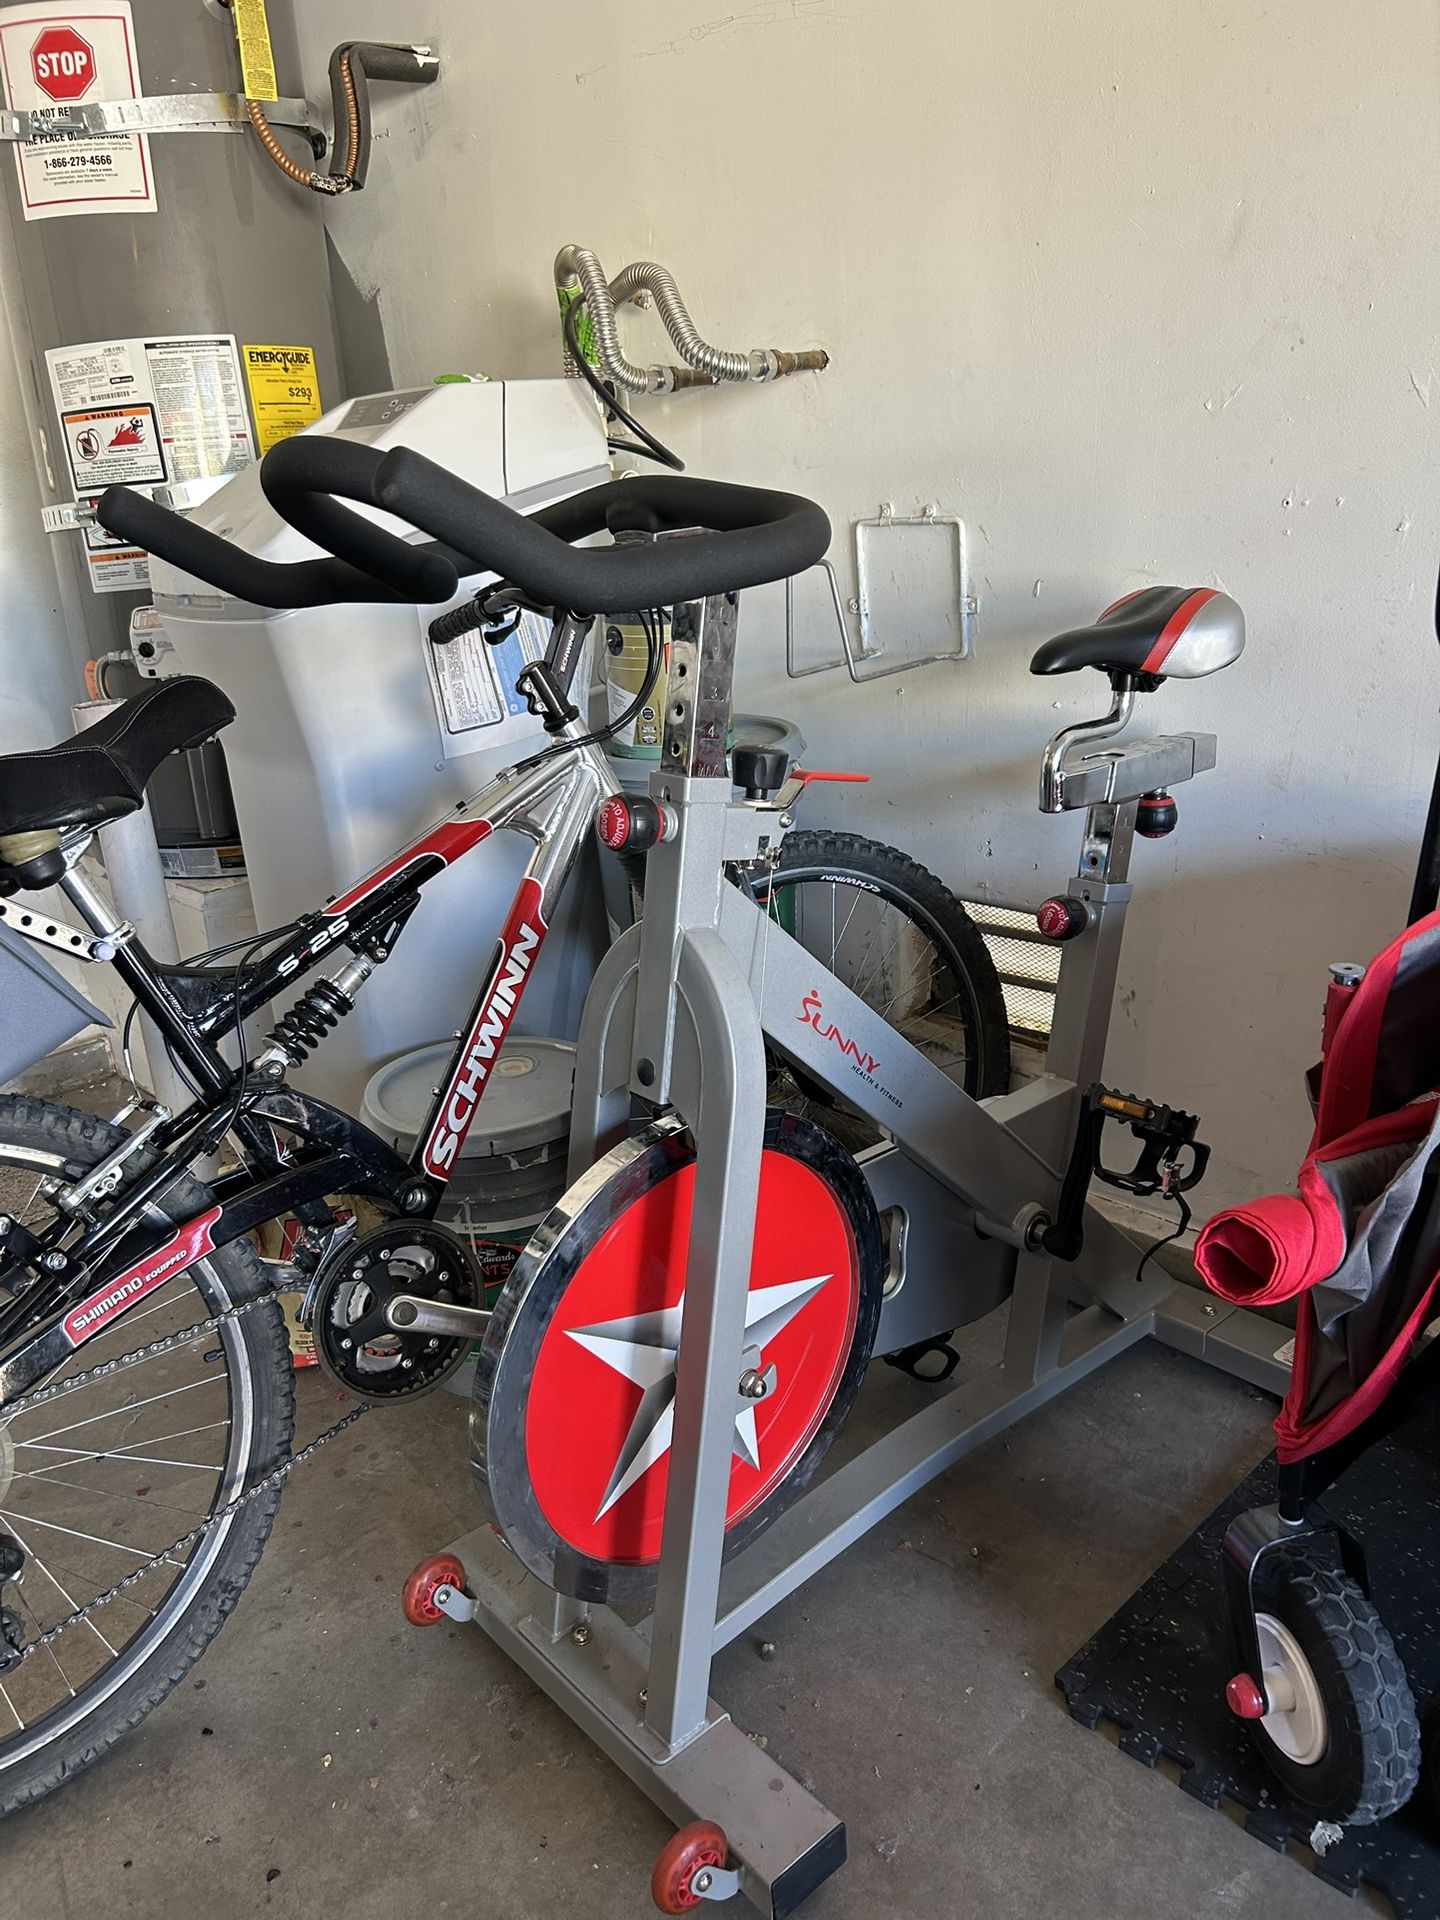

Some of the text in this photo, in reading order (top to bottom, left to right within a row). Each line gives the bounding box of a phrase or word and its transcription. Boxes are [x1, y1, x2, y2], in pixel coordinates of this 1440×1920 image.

[37, 51, 88, 78] STOP
[39, 109, 55, 117] NOT
[40, 133, 65, 144] PLACE
[44, 155, 112, 169] 1-866-279-4566
[248, 351, 311, 365] ENERGYGUIDE
[288, 387, 312, 398] $293
[91, 411, 124, 419] WARNING
[560, 629, 576, 673] SCHWINN
[611, 804, 625, 847] TO ADJUST
[821, 875, 881, 893] SCHWINN
[795, 990, 881, 1073] SUNNY
[431, 922, 540, 1170] SCHWINN
[851, 1064, 903, 1108] HEALTH & FITNESS
[72, 1249, 188, 1331] SHIMANO EQUIPPED
